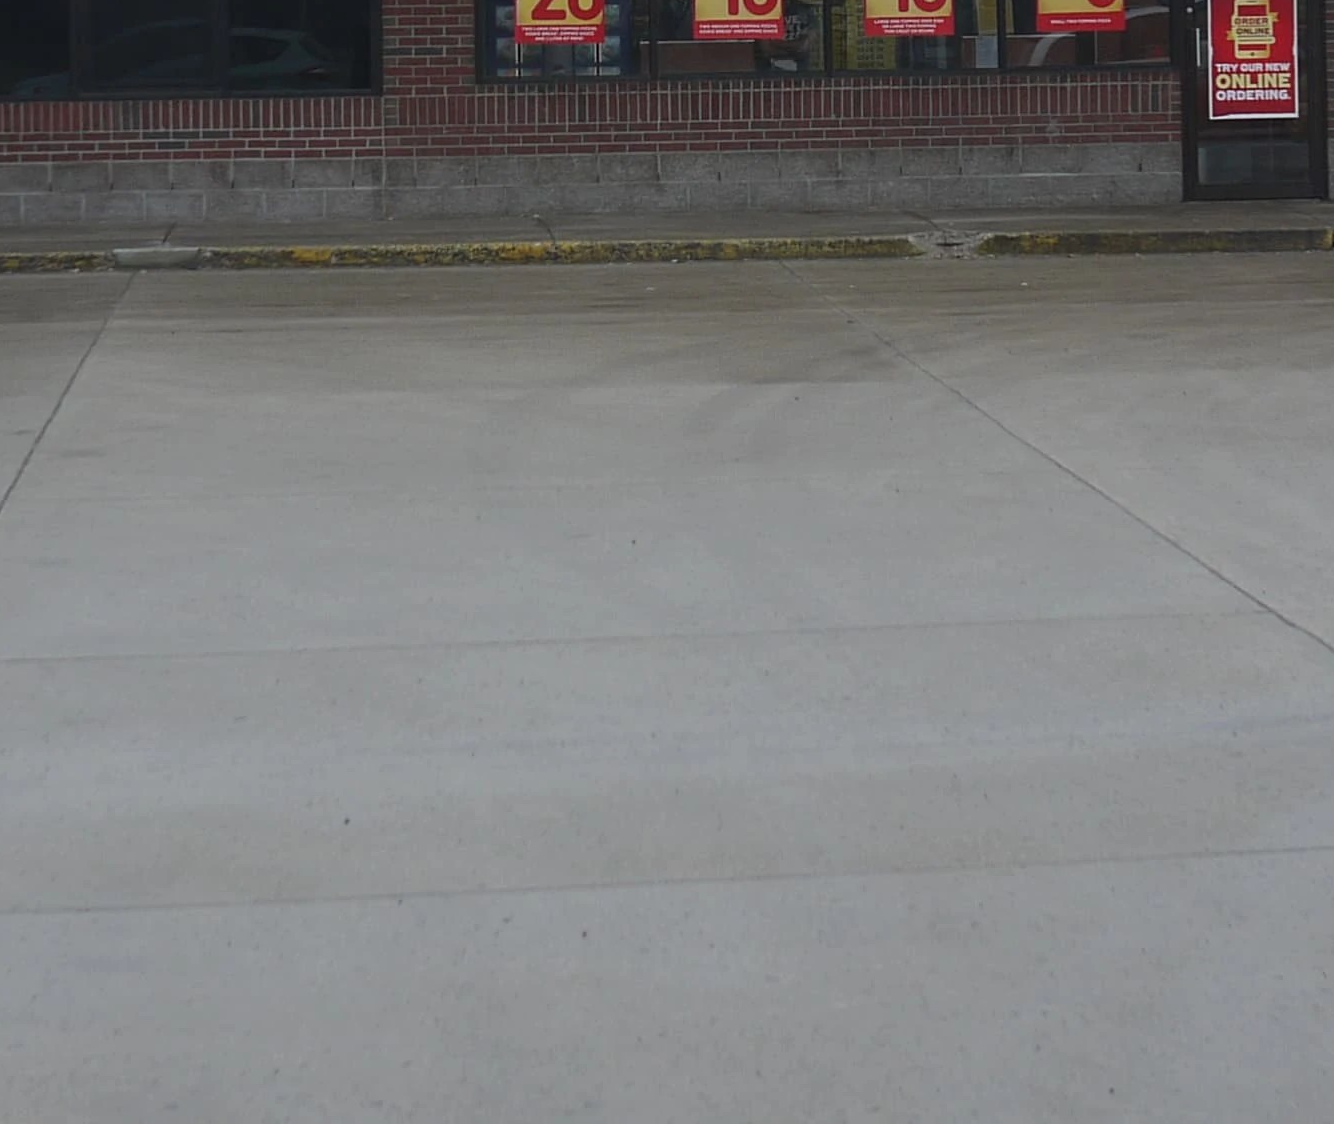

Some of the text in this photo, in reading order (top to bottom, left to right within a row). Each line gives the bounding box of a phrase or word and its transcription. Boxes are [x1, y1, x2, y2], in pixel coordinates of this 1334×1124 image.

[1234, 17, 1269, 26] ORDER
[1235, 27, 1271, 35] ONLINE
[1215, 62, 1291, 73] TRY OUR NEW
[1215, 73, 1291, 89] ONLINE
[1215, 89, 1291, 102] ORDERING.
